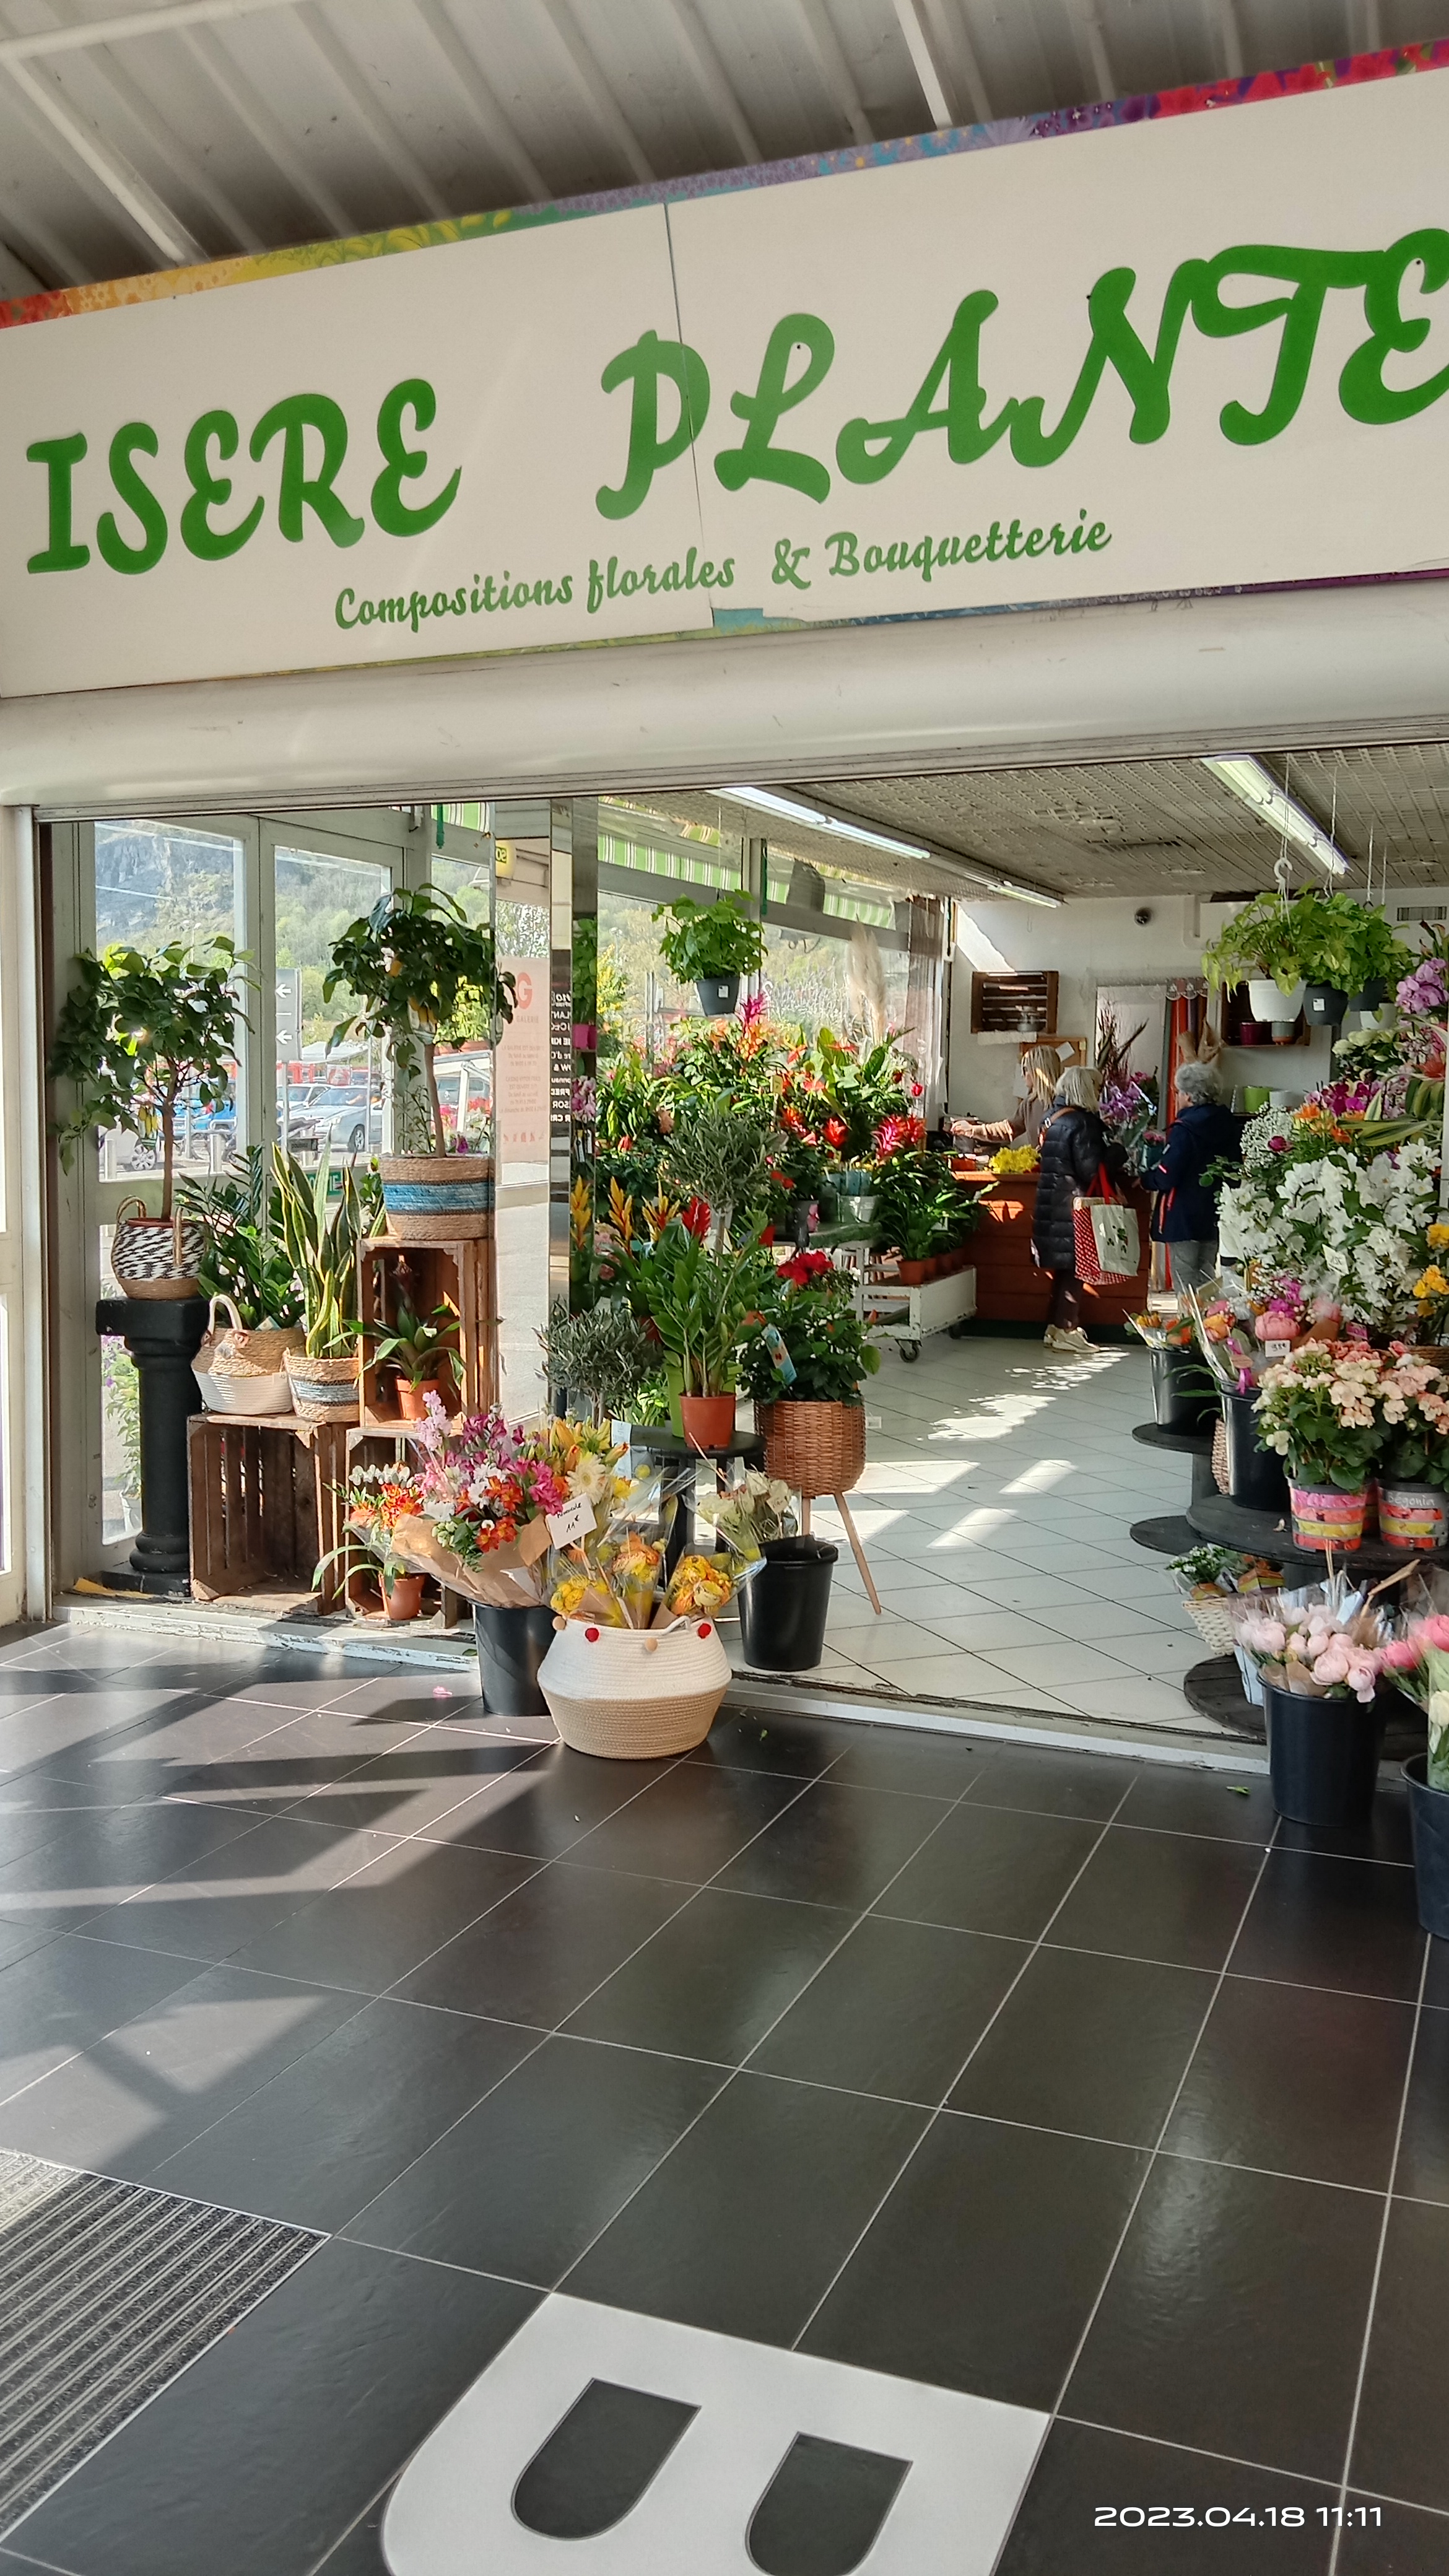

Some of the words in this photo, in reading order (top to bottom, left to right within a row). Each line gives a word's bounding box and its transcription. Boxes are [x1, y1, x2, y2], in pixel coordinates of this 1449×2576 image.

[27, 378, 462, 575] ISERE
[335, 570, 573, 633] Compositions
[586, 547, 735, 614] florales
[772, 539, 811, 589] &
[825, 508, 1112, 583] Bouquetterie
[516, 972, 533, 1009] G
[516, 1016, 539, 1024] GALERIE
[1387, 1491, 1435, 1507] Bégonia
